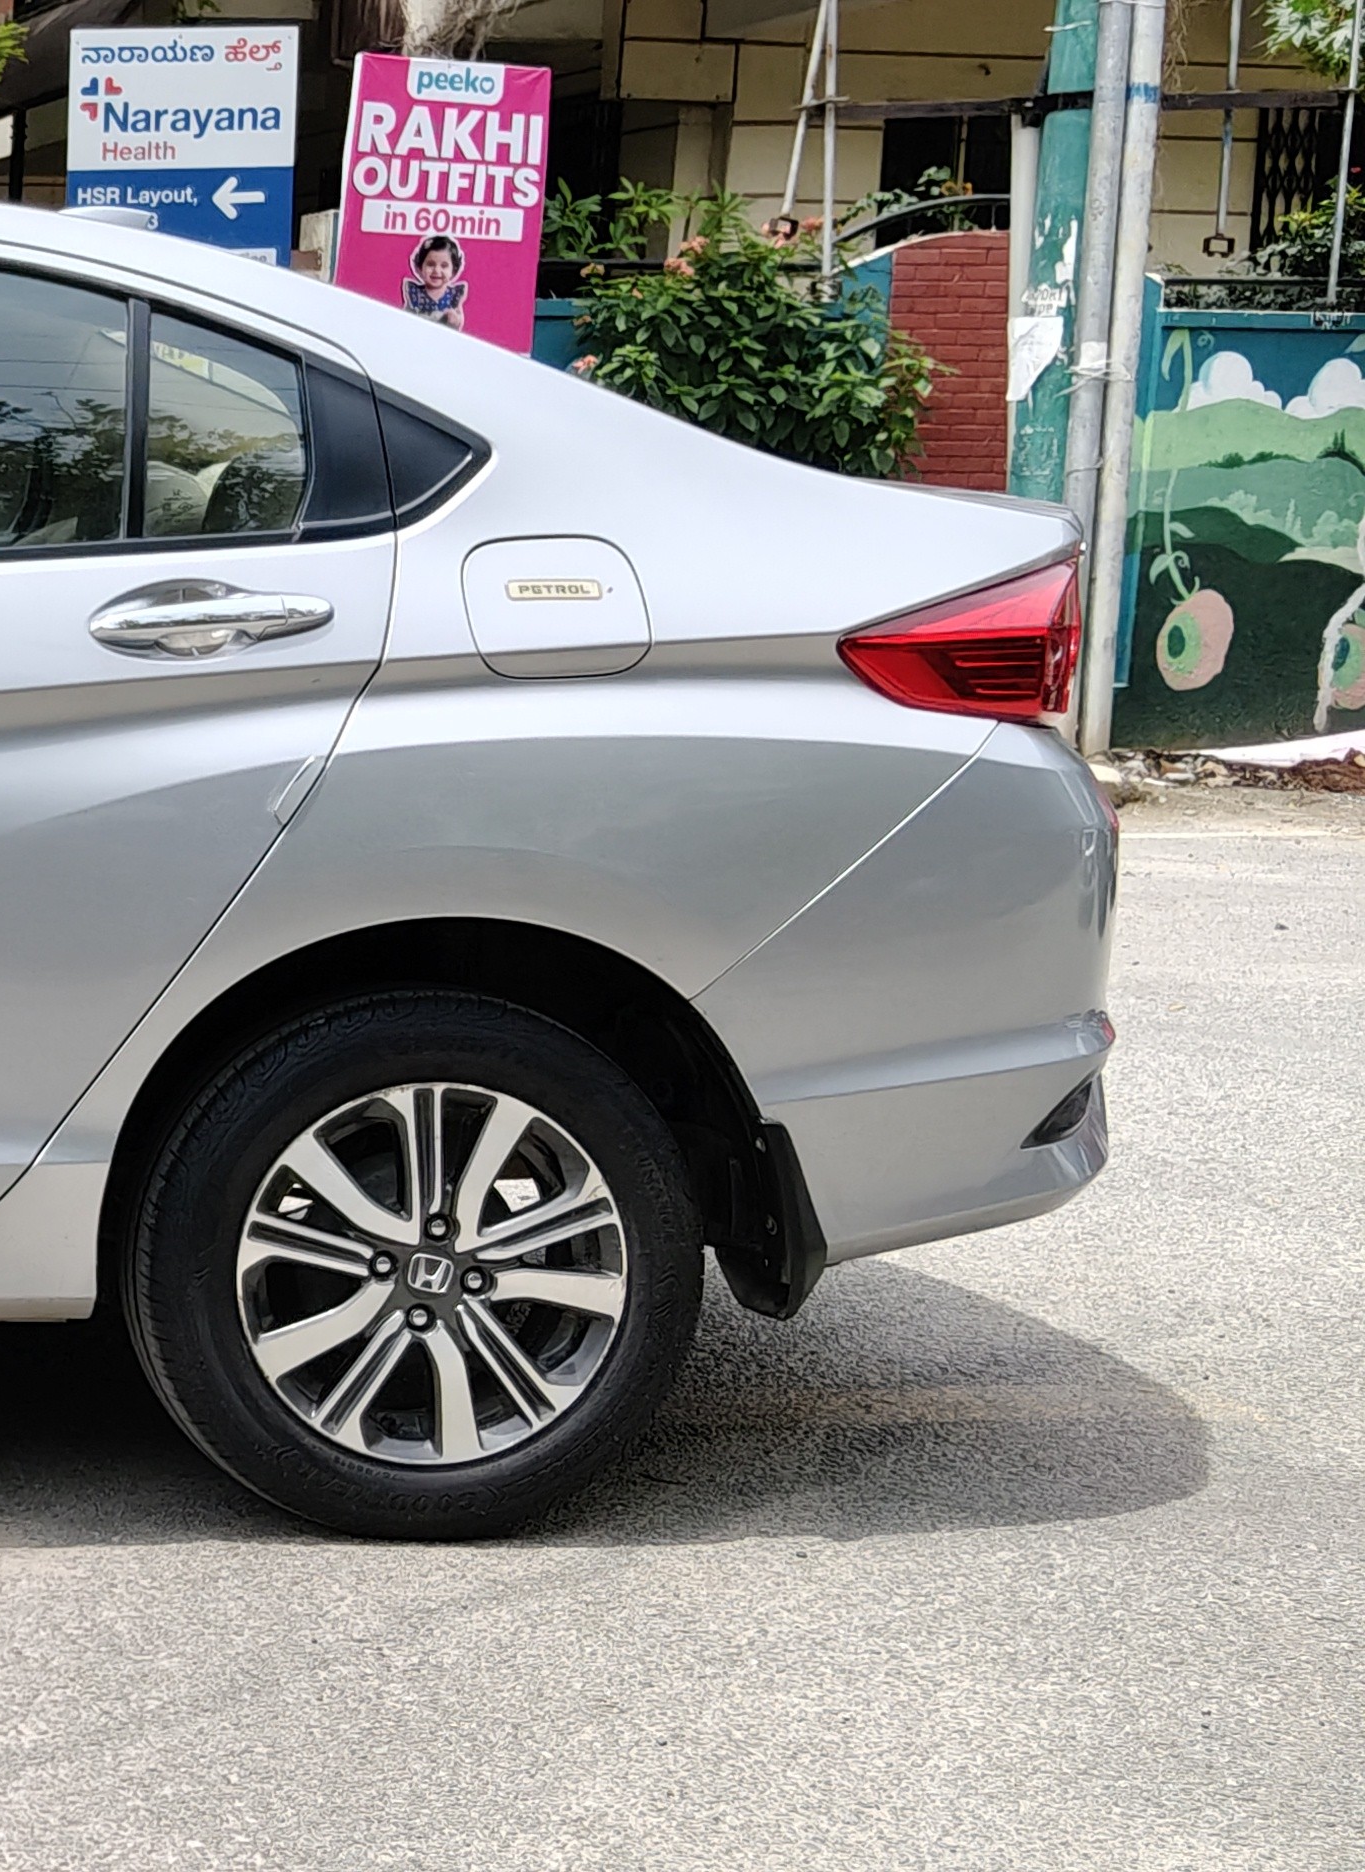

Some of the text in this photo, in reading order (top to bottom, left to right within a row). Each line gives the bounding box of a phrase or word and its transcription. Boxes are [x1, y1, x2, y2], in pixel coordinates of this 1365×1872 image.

[81, 39, 215, 64] ನಾರಾಯಣ
[416, 67, 495, 95] peeko
[103, 101, 281, 139] Narayana
[357, 100, 544, 166] RAKHI
[101, 141, 176, 161] Health
[352, 156, 541, 208] OUTFITS
[77, 187, 198, 208] HSR Layout,
[383, 204, 501, 237] in 60min
